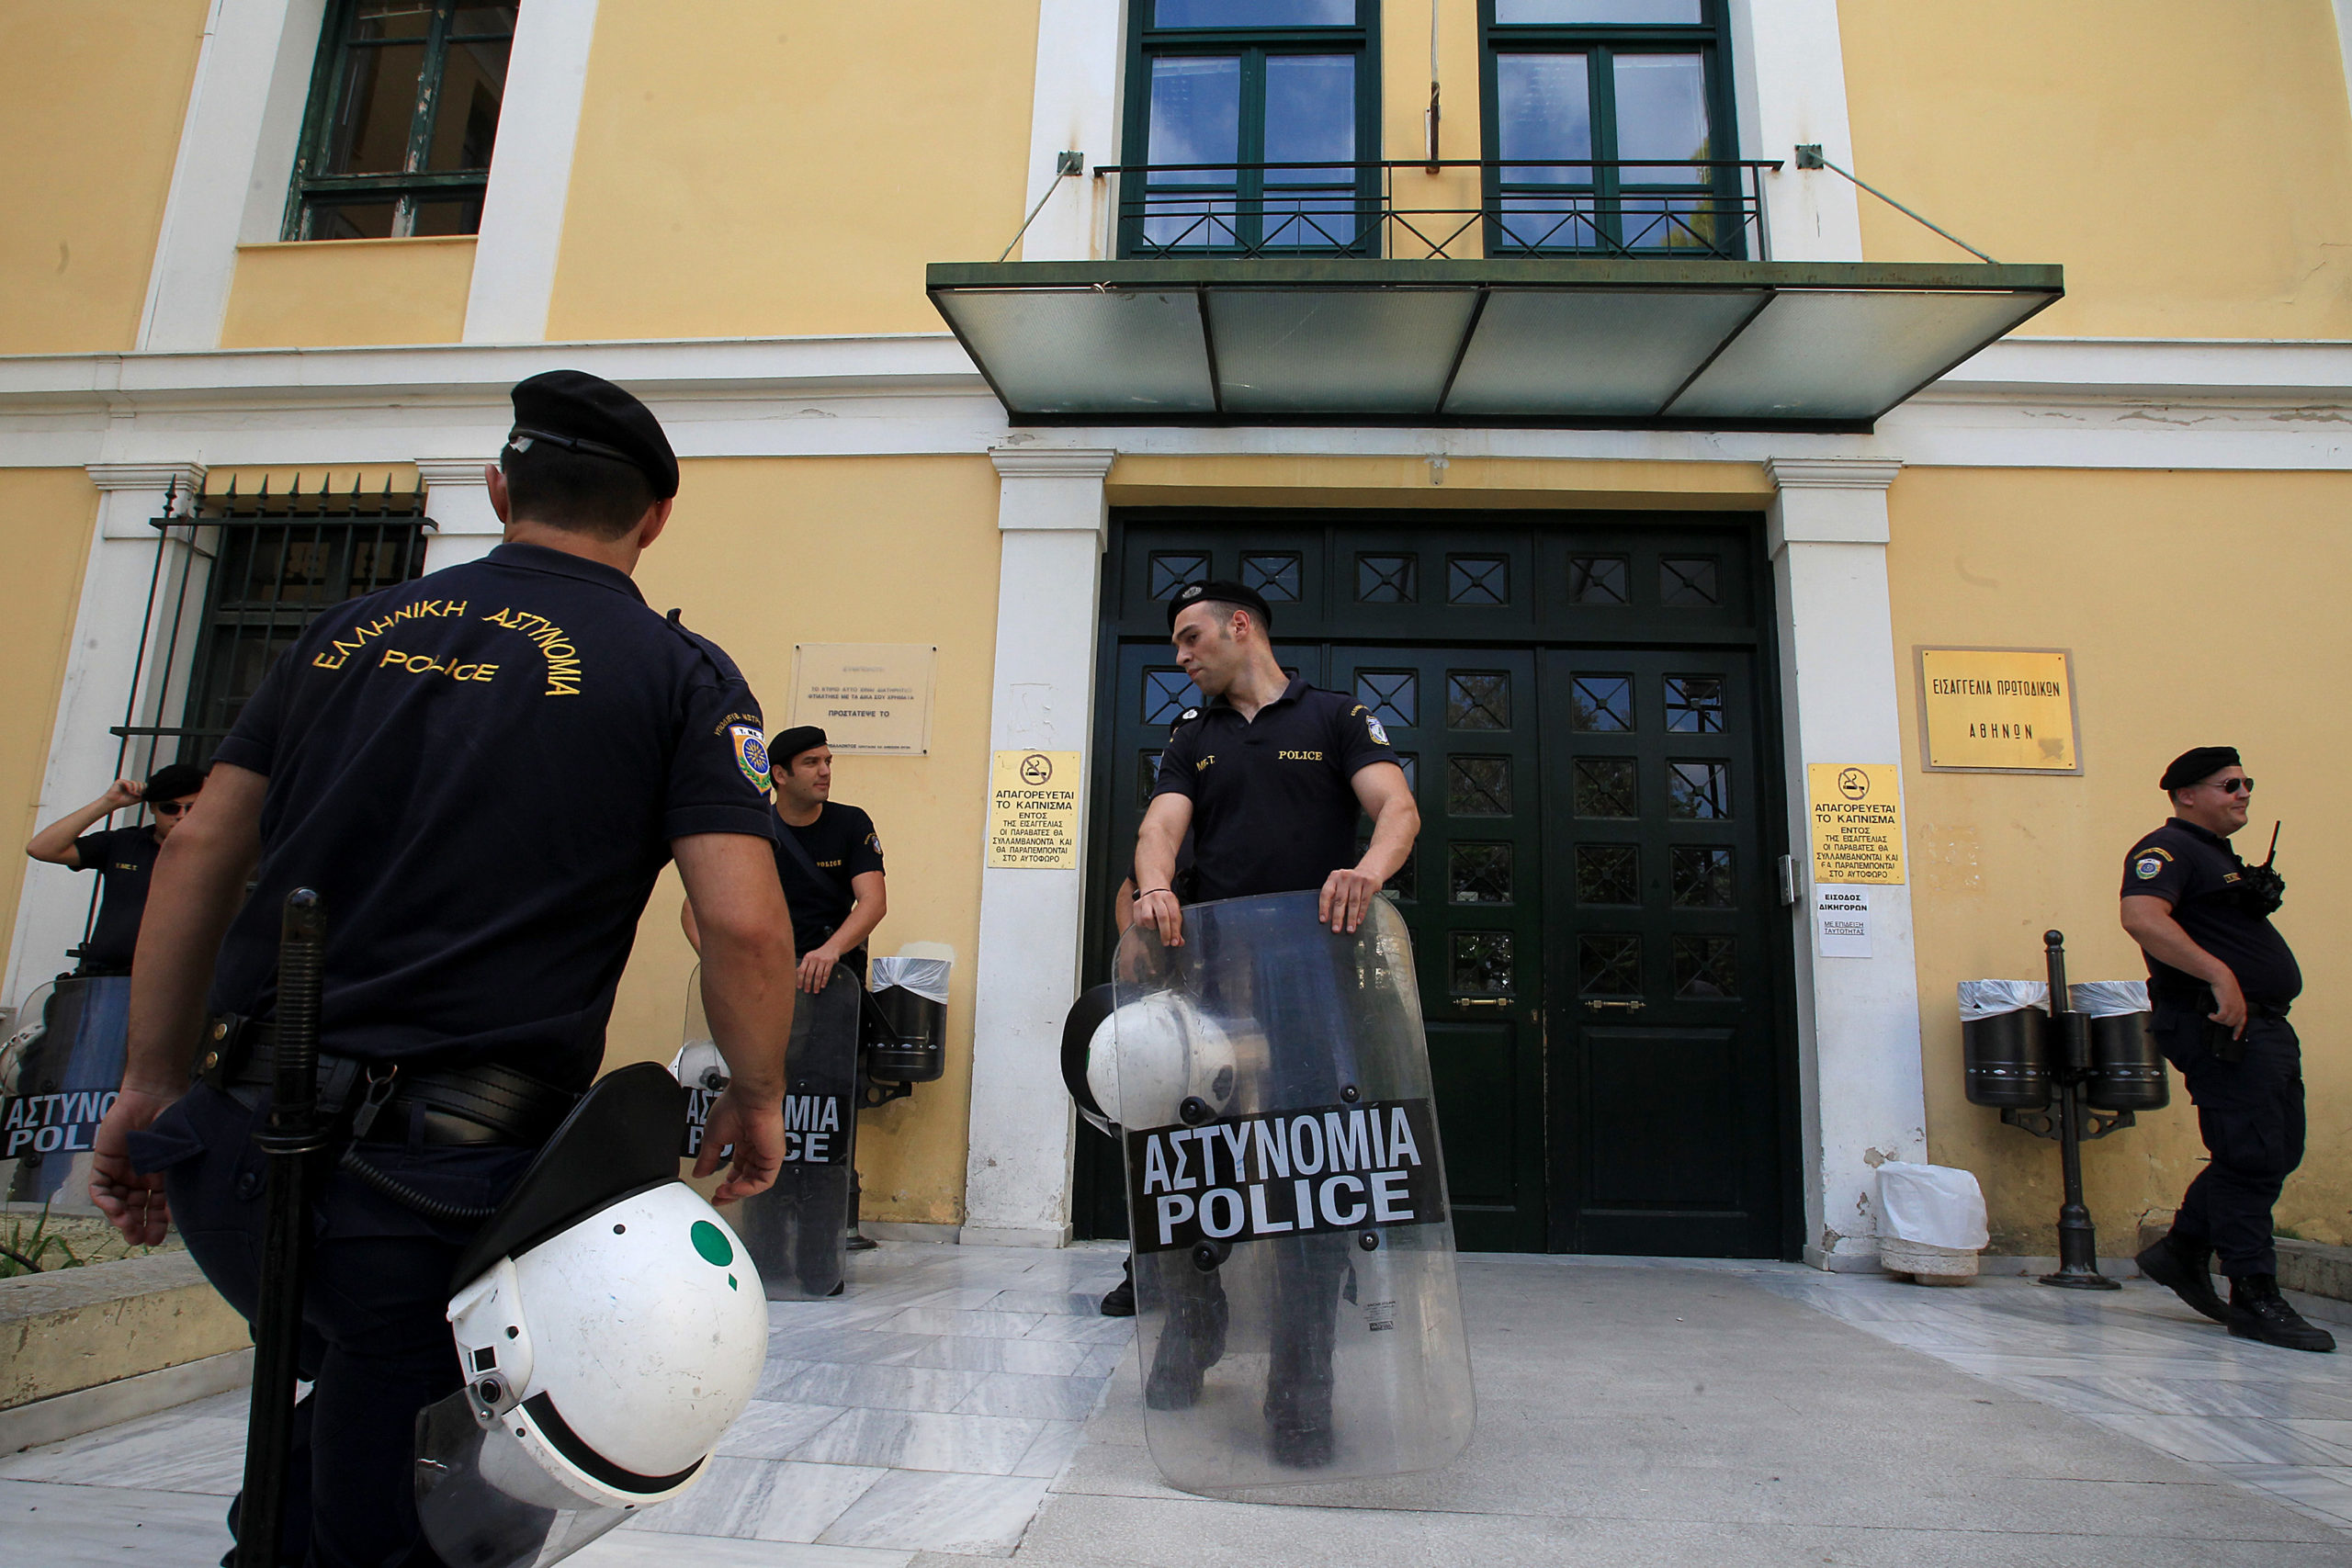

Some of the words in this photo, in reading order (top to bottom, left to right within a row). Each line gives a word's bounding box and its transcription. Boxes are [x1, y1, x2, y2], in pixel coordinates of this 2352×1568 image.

[312, 600, 468, 670] ΕΛΛΗΝΙΚΗ
[480, 607, 582, 696] ΑΣΤΥΝΟΜΙΑ
[379, 649, 500, 682] POLICE
[1933, 679, 1992, 695] ΕΙΣΑΓΓΕΛΙΑ
[1997, 680, 2061, 697] ΠΡΩΤΟΔΙΚΩΝ
[1969, 723, 2032, 739] ΑΘΗΝΩΝ
[1278, 750, 1323, 761] POLICE
[996, 790, 1074, 800] ΑΠΑΓΟΡΕΥΕΤΑΙ
[996, 800, 1011, 809] ΤΟ
[1016, 801, 1072, 810] ΚΑΠΝΙΣΜΑ
[1815, 804, 1895, 813] ΑΠΑΓΟΡΕΥΕΤΑΙ
[1815, 814, 1831, 823] ΤΟ
[1838, 815, 1895, 824] ΚΑΠΝΙΣΜΑ
[1010, 846, 1068, 854] ΠΑΡΑΠΕΜΠΟΝΤΑΙ
[1816, 852, 1882, 862] ΣΥΛΛΑΜΒΑΝΟΝΤΑΙ
[1835, 862, 1894, 870] ΠΑΡΑΠΕΜΠΟΝΤΑΙ
[686, 1089, 840, 1133] ΑΣΜΙΑ
[6, 1122, 101, 1156] POL
[688, 1125, 831, 1163] PCE
[1143, 1106, 1421, 1195] ΑΣΤΥΝΟΜΙΑ
[1156, 1169, 1415, 1245] POLICE
